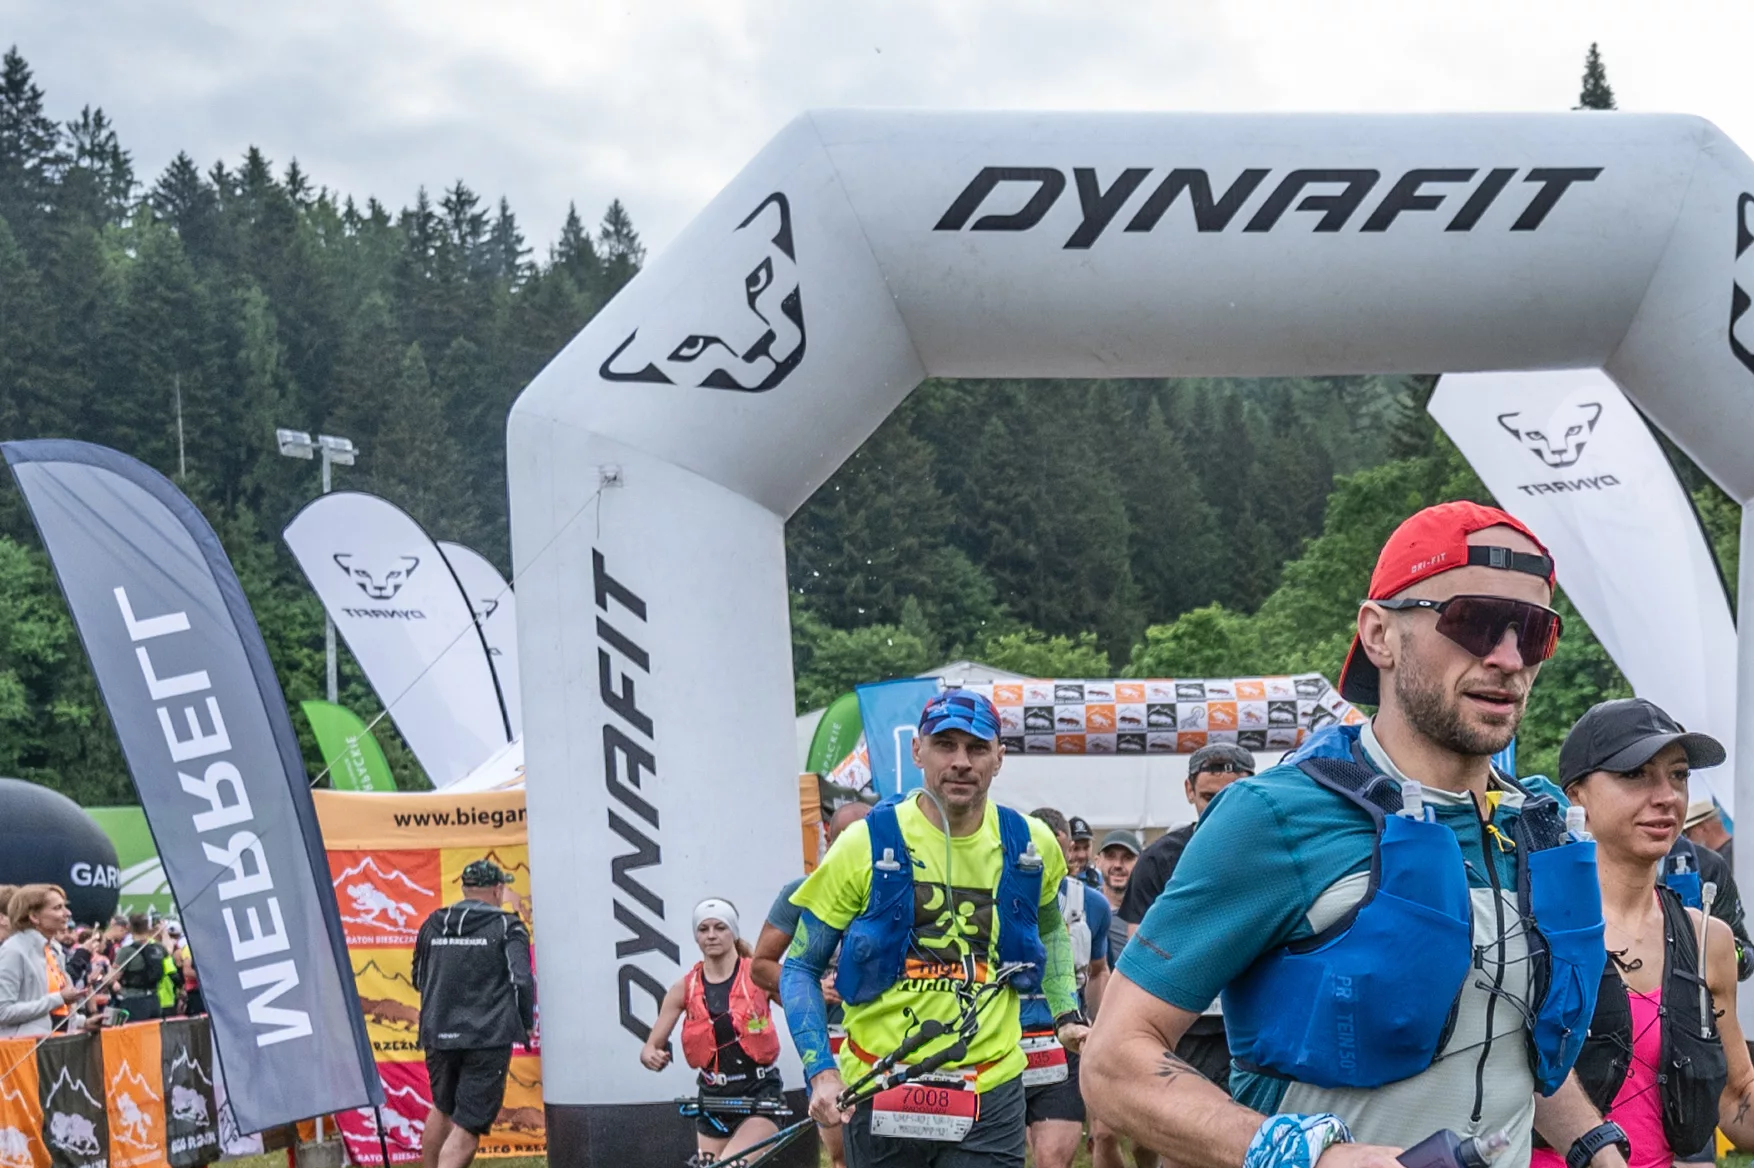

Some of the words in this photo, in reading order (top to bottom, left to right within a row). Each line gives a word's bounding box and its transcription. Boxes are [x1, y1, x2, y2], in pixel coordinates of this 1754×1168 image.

[933, 166, 1604, 250] DYNAFIT
[1410, 552, 1447, 574] DRI-FIT
[592, 547, 681, 1062] DYNAFIT
[70, 861, 121, 889] GAR
[902, 1087, 950, 1108] 7008
